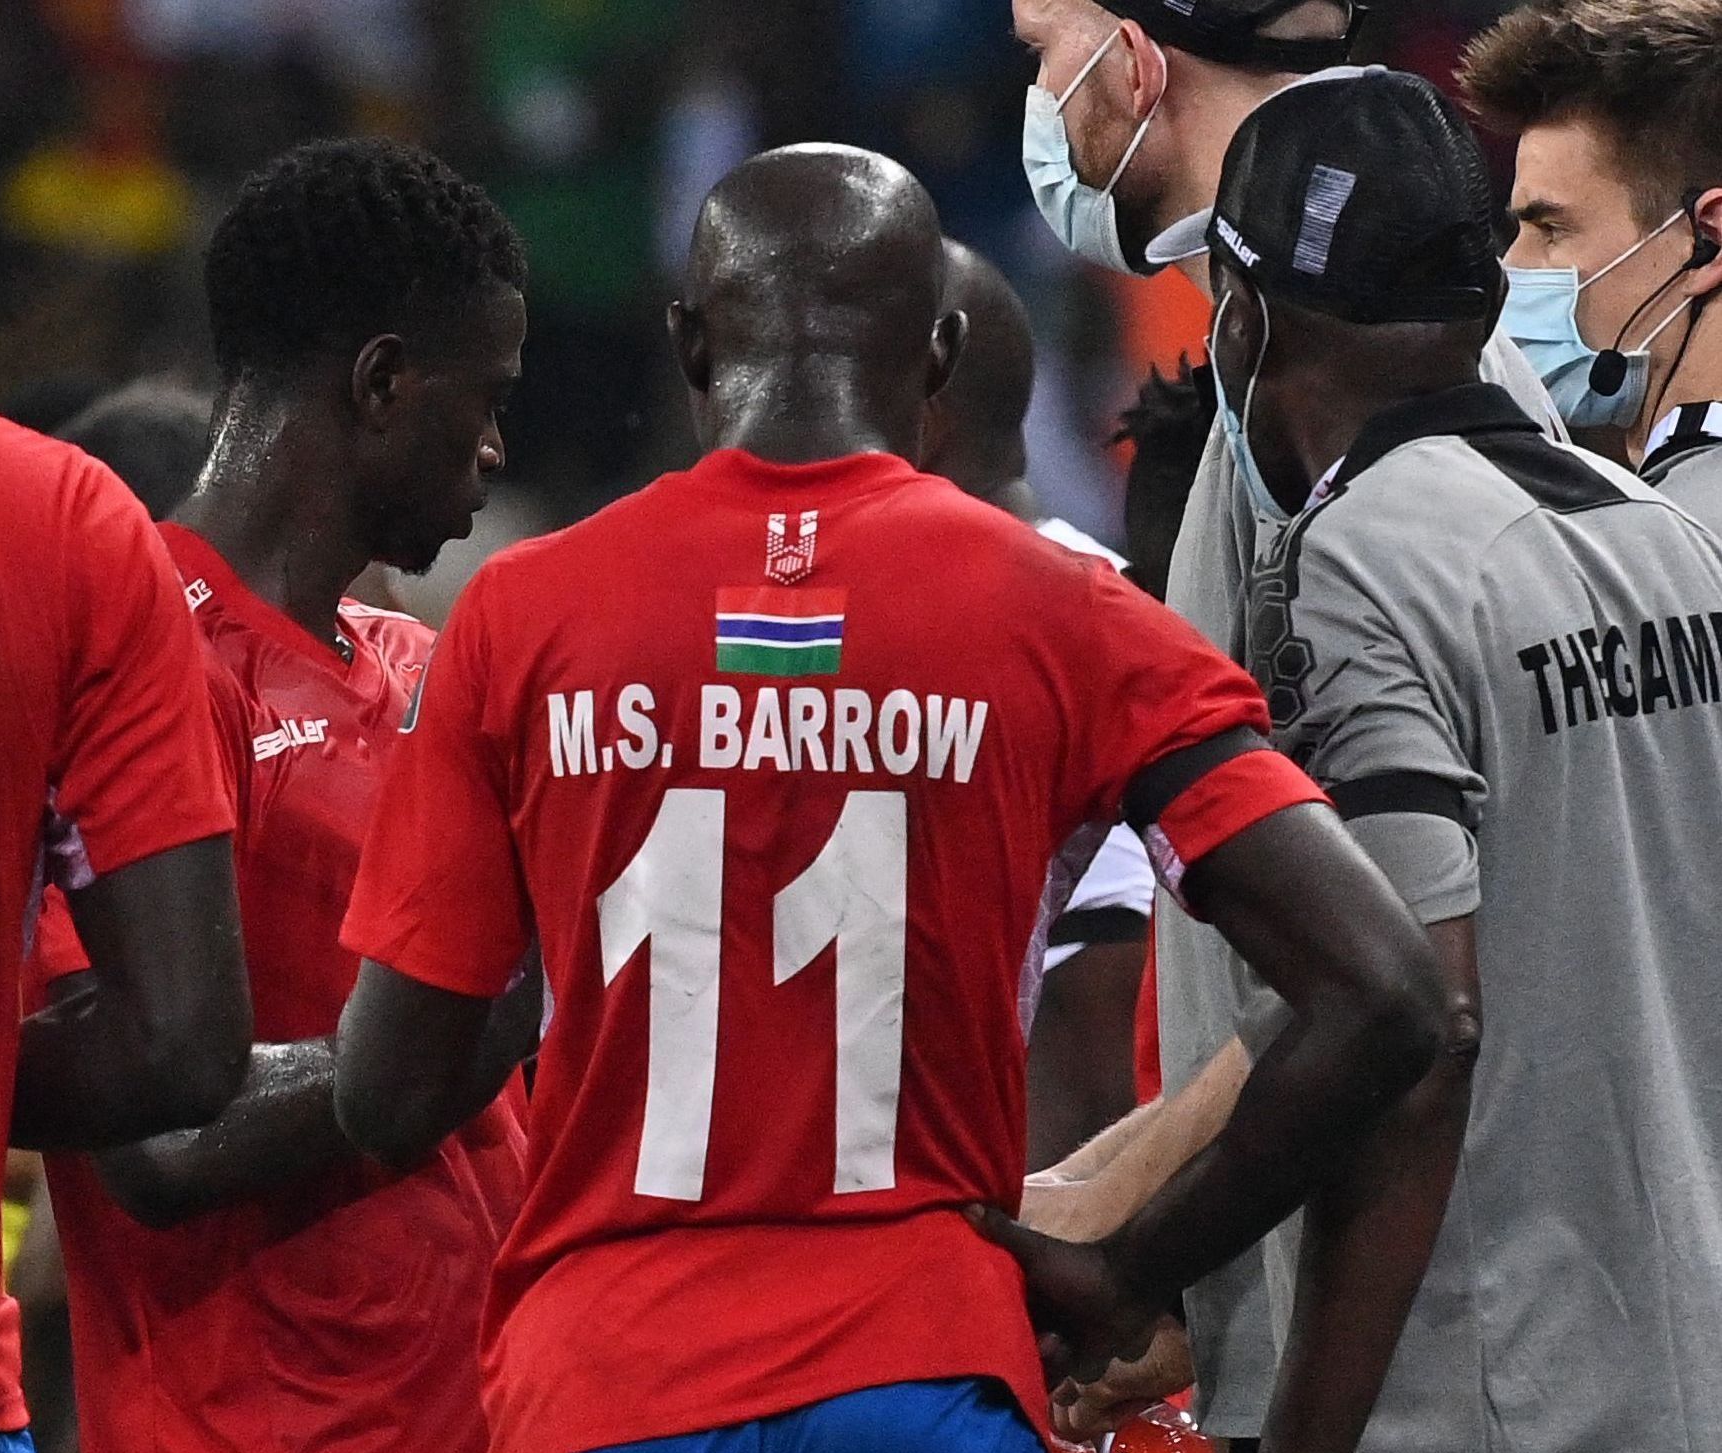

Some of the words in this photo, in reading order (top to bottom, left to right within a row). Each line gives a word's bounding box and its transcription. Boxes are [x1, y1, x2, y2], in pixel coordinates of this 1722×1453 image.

[1602, 611, 1722, 717] GAM
[547, 683, 674, 778] M.S.
[699, 683, 990, 784] BARROW
[597, 787, 908, 1201] 11
